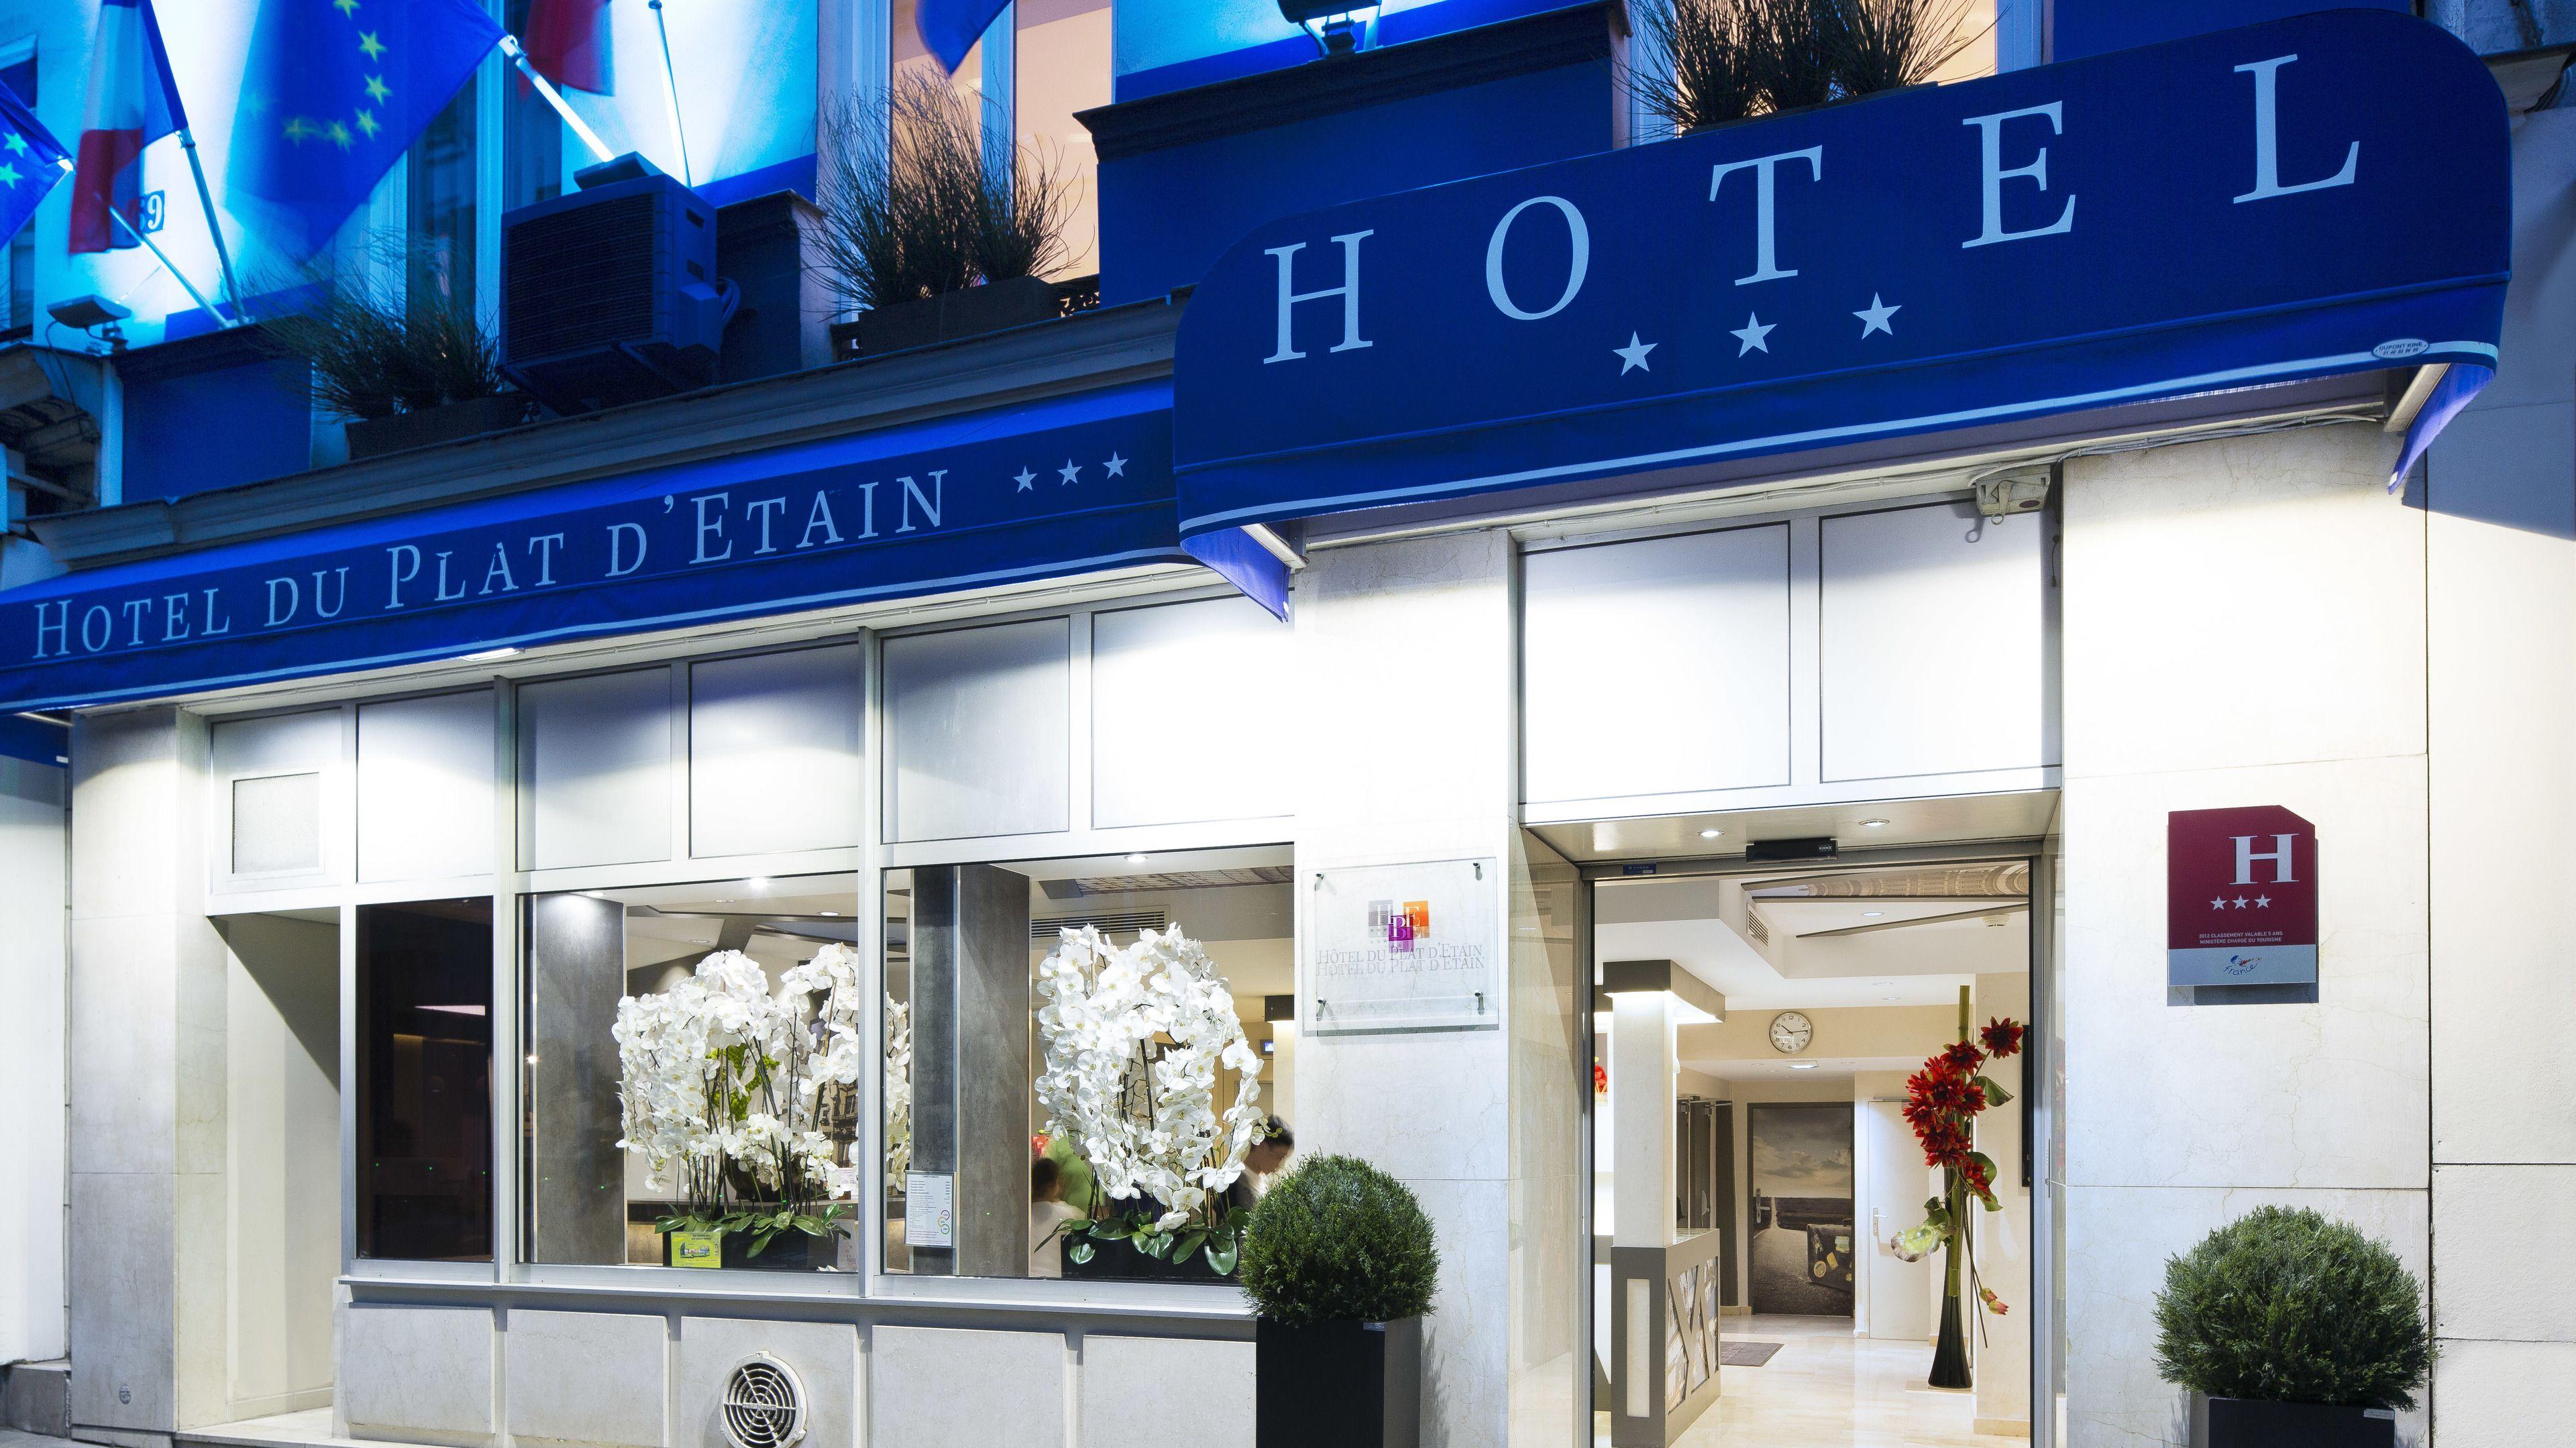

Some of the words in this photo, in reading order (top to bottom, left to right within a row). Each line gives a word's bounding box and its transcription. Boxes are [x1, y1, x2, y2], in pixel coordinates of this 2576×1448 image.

[1264, 54, 2359, 364] HOTEL
[32, 588, 230, 659] HOTEL
[264, 567, 349, 627] DU
[385, 532, 564, 610] PLAT
[604, 469, 948, 577] D'ETAIN
[2229, 833, 2300, 885] H
[1320, 948, 1363, 964] HÔTEL
[1367, 950, 1386, 962] DU
[1390, 946, 1425, 960] PLAT
[1428, 943, 1483, 959] D'ETAIN
